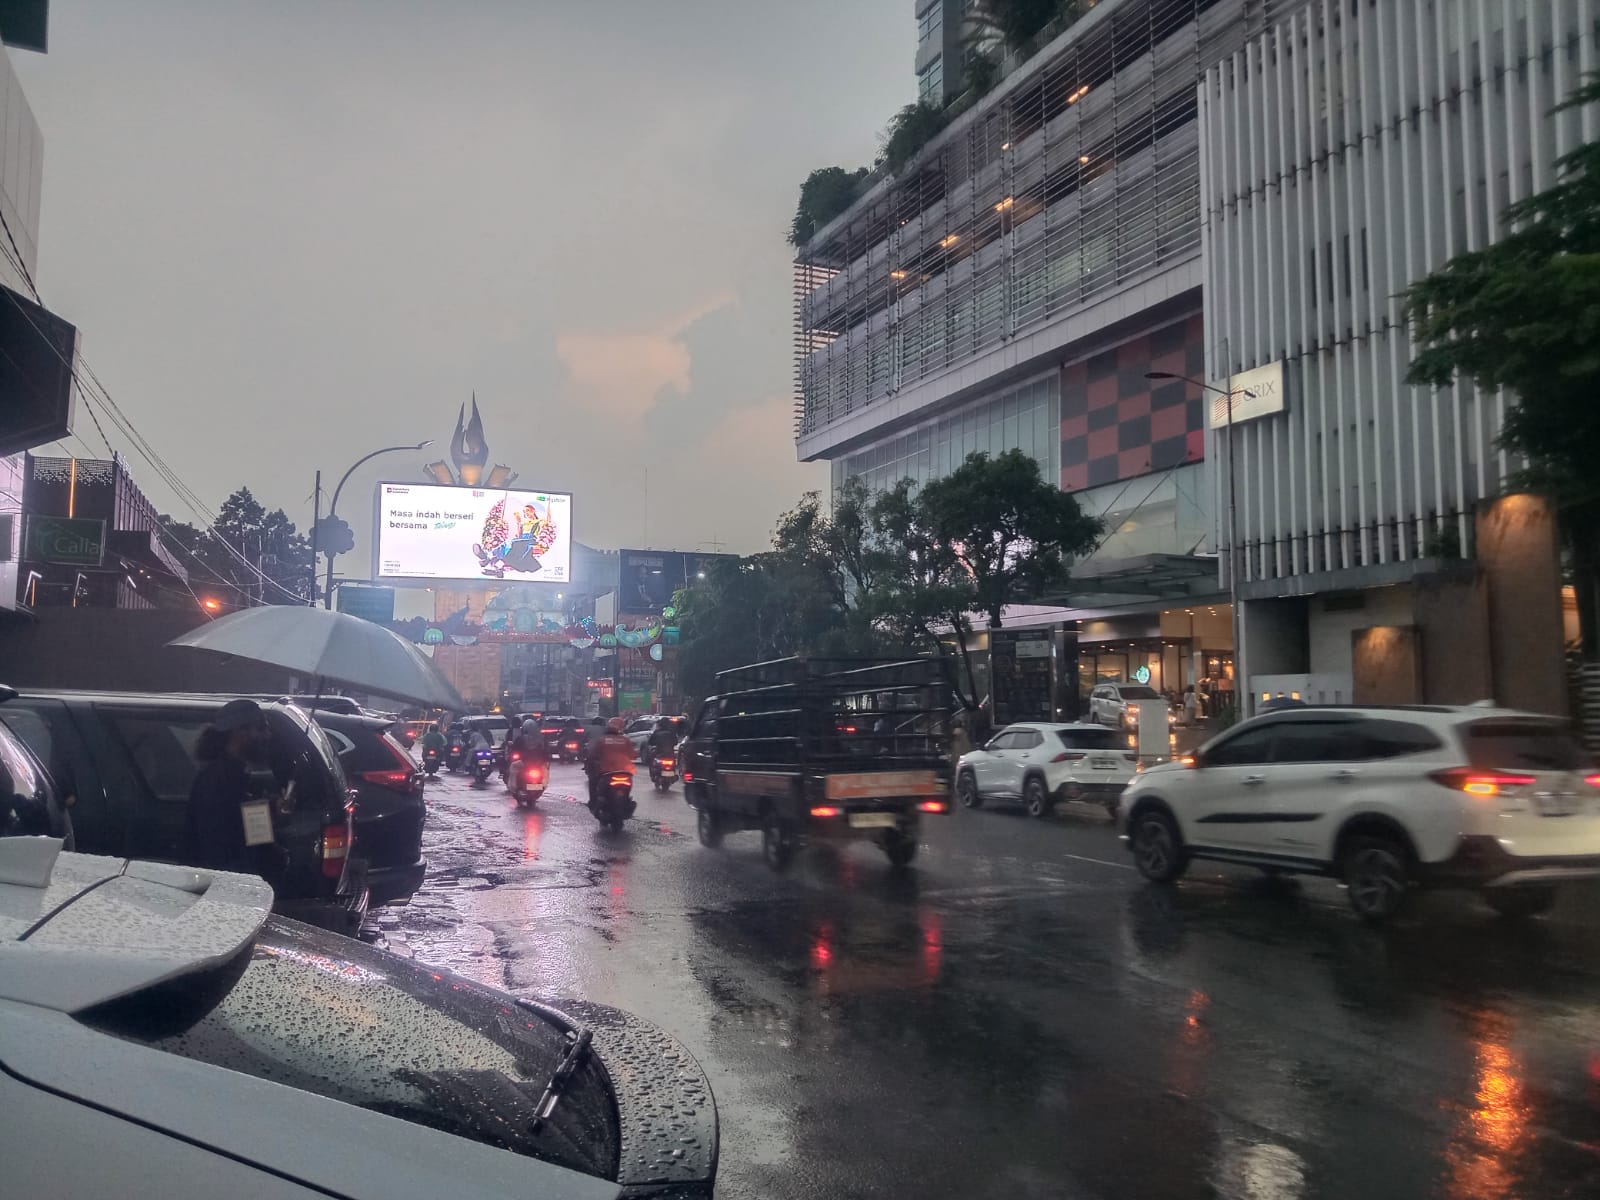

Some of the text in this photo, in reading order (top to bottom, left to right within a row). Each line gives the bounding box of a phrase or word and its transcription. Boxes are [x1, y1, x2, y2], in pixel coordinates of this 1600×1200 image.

[390, 509, 474, 520] Masa indah berseri
[389, 520, 428, 530] bersama
